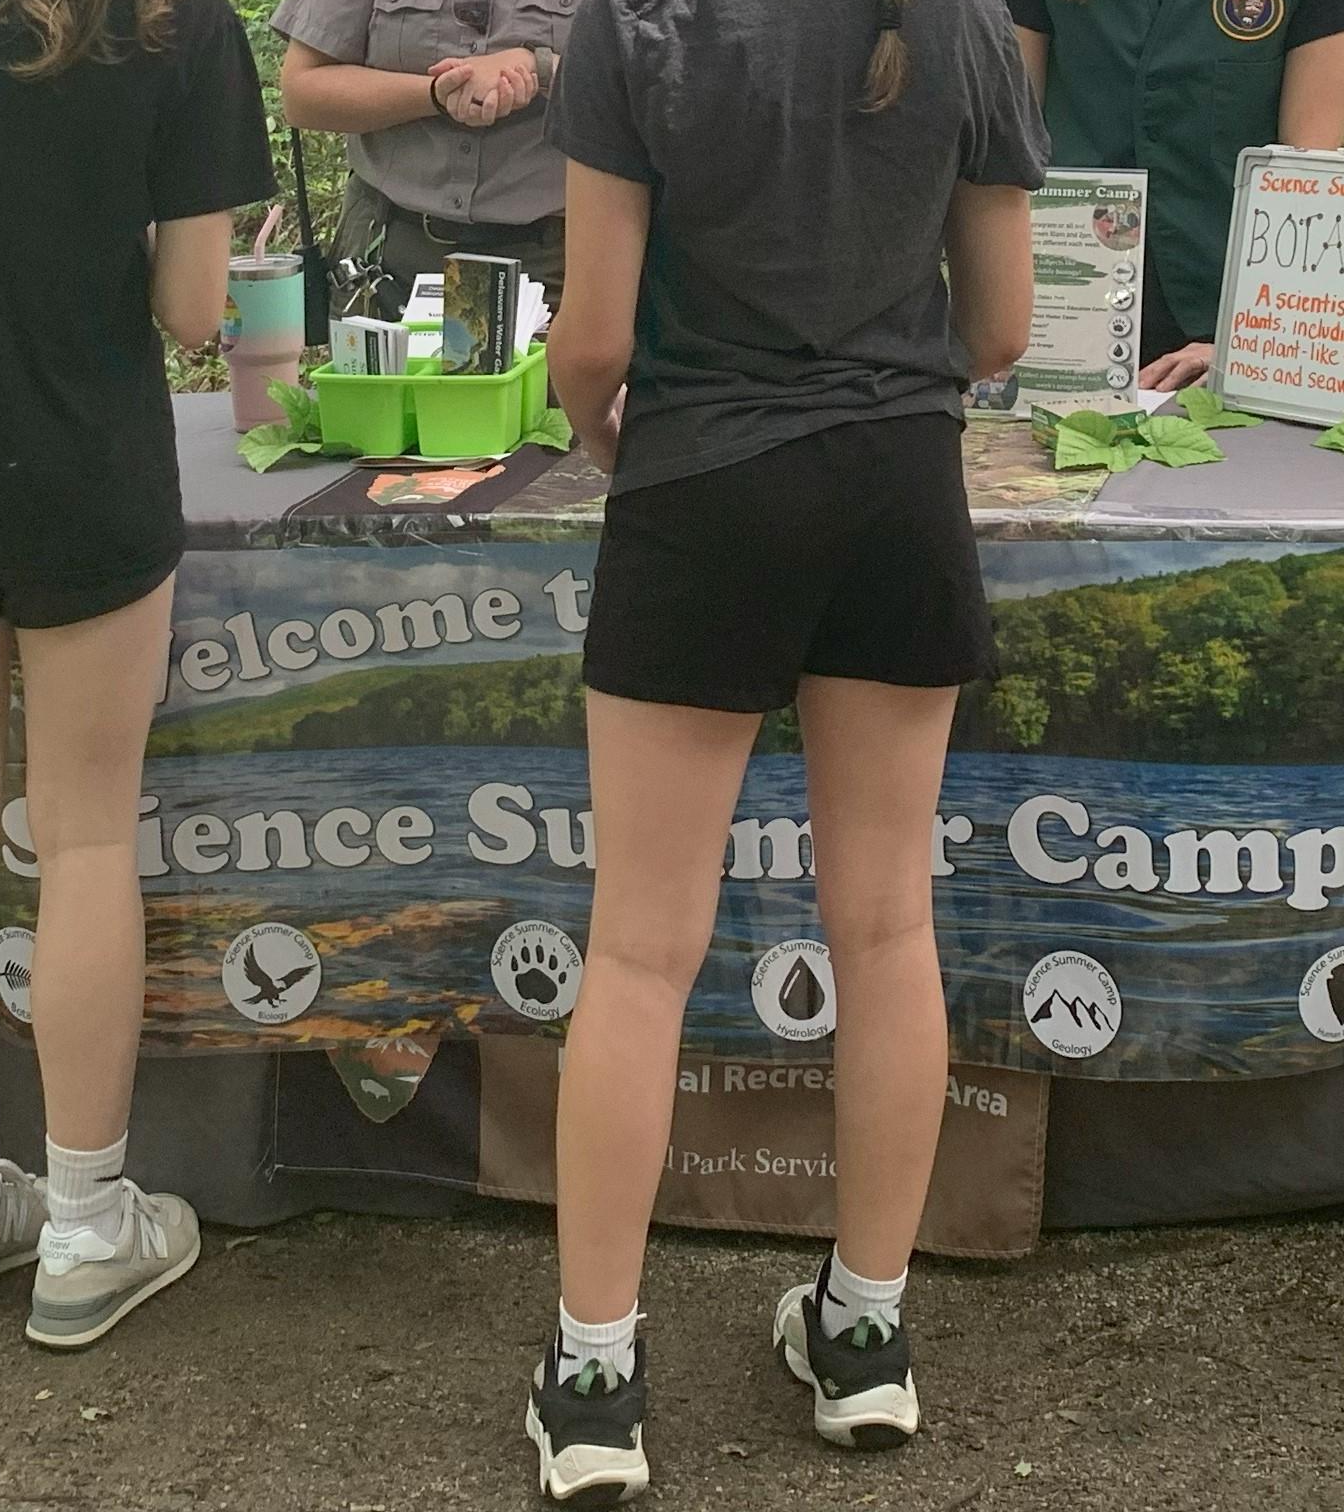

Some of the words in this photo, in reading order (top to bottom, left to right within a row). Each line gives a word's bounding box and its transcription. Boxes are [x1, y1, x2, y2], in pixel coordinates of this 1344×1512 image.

[1096, 187, 1139, 201] Camp
[1259, 171, 1320, 194] Science
[496, 271, 505, 322] Delaware
[1255, 283, 1271, 306] A
[1235, 309, 1286, 333] plants,
[494, 323, 504, 358] Water
[1231, 334, 1258, 353] and
[1263, 336, 1340, 366] plant-like
[1230, 360, 1268, 382] moss
[1273, 365, 1302, 387] and
[156, 588, 521, 704] elcome
[2, 796, 435, 879] Sience
[225, 934, 252, 965] Science
[251, 926, 294, 938] Summer
[293, 933, 314, 961] Camp
[492, 931, 516, 967] Science
[514, 923, 559, 936] Summer
[559, 935, 580, 967] Camp
[752, 951, 780, 988] Science
[778, 941, 827, 956] Summer
[1300, 960, 1327, 997] Science
[1025, 961, 1053, 998] Science
[1051, 955, 1098, 973] Summer
[1097, 971, 1117, 1006] Camp
[257, 1011, 288, 1021] Biology
[520, 1000, 560, 1018] Ecology
[776, 1023, 829, 1038] Hydrology
[1052, 1039, 1092, 1056] Geology
[681, 1146, 746, 1176] Park
[49, 1240, 71, 1250] new
